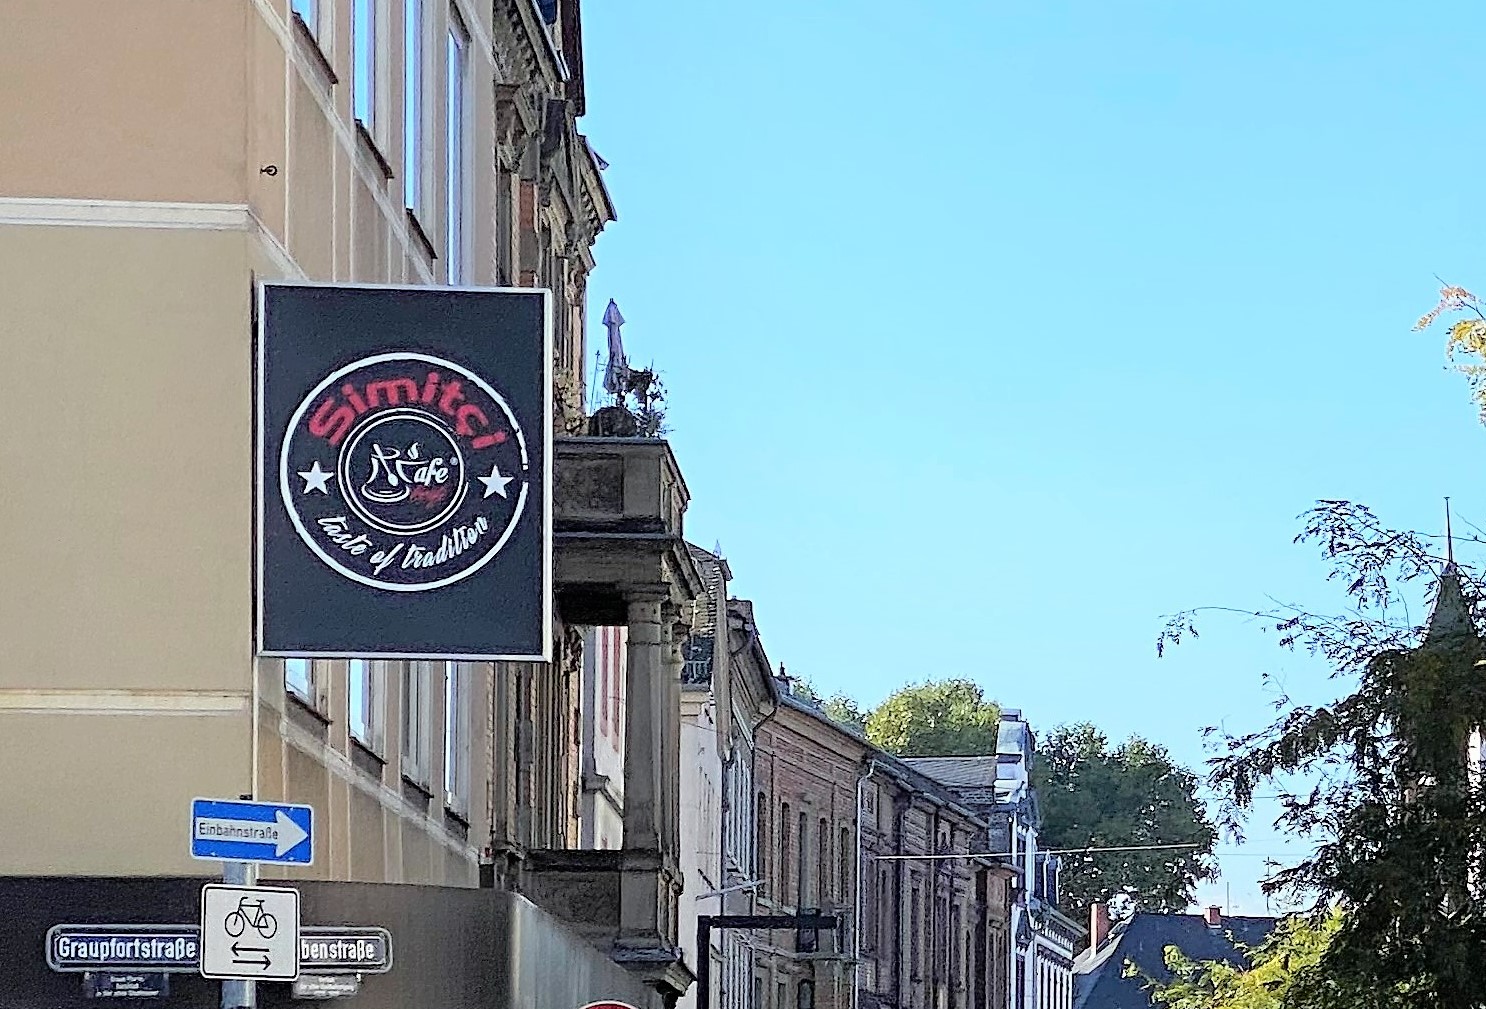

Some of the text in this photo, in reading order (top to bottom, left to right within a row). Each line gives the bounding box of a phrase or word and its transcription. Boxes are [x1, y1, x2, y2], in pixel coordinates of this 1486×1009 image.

[369, 543, 405, 576] of
[199, 822, 279, 840] Einbahnstraße
[58, 937, 197, 961] Graupfortstraße
